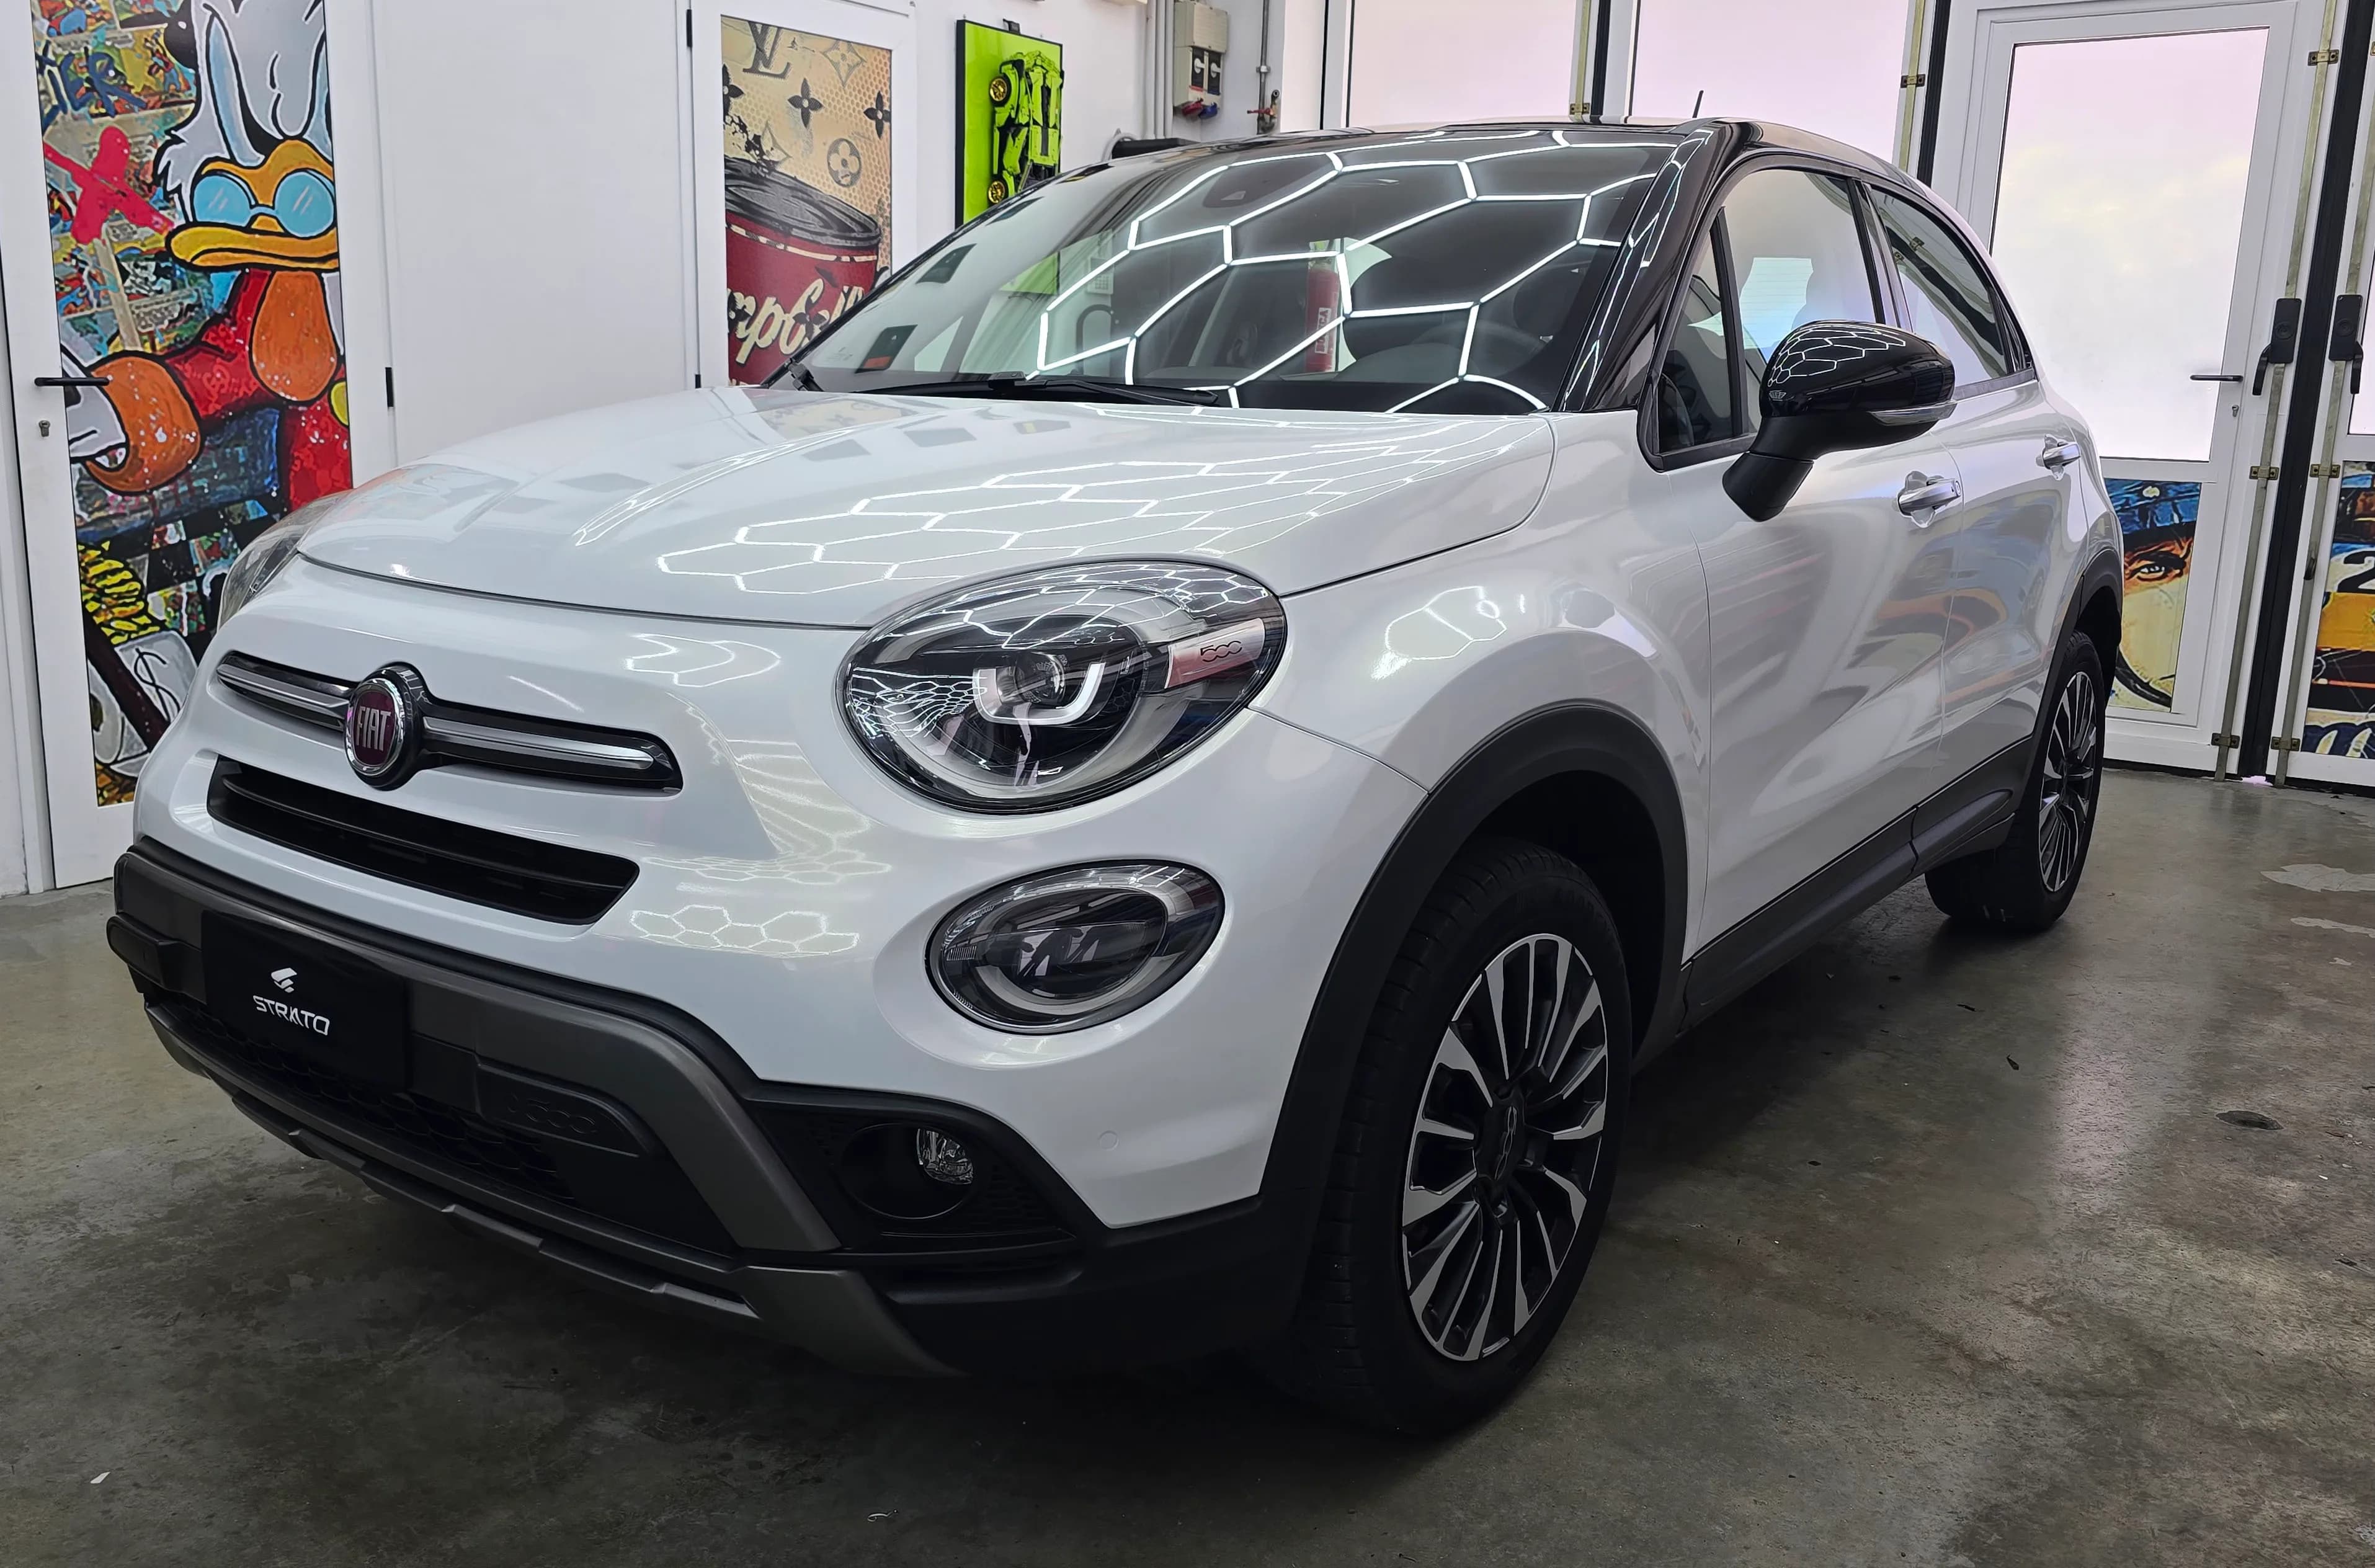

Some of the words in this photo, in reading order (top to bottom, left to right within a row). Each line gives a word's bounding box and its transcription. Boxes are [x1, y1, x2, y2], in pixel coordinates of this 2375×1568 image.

[1200, 641, 1242, 662] 500
[356, 706, 391, 752] FIAT
[253, 995, 330, 1036] STRATO
